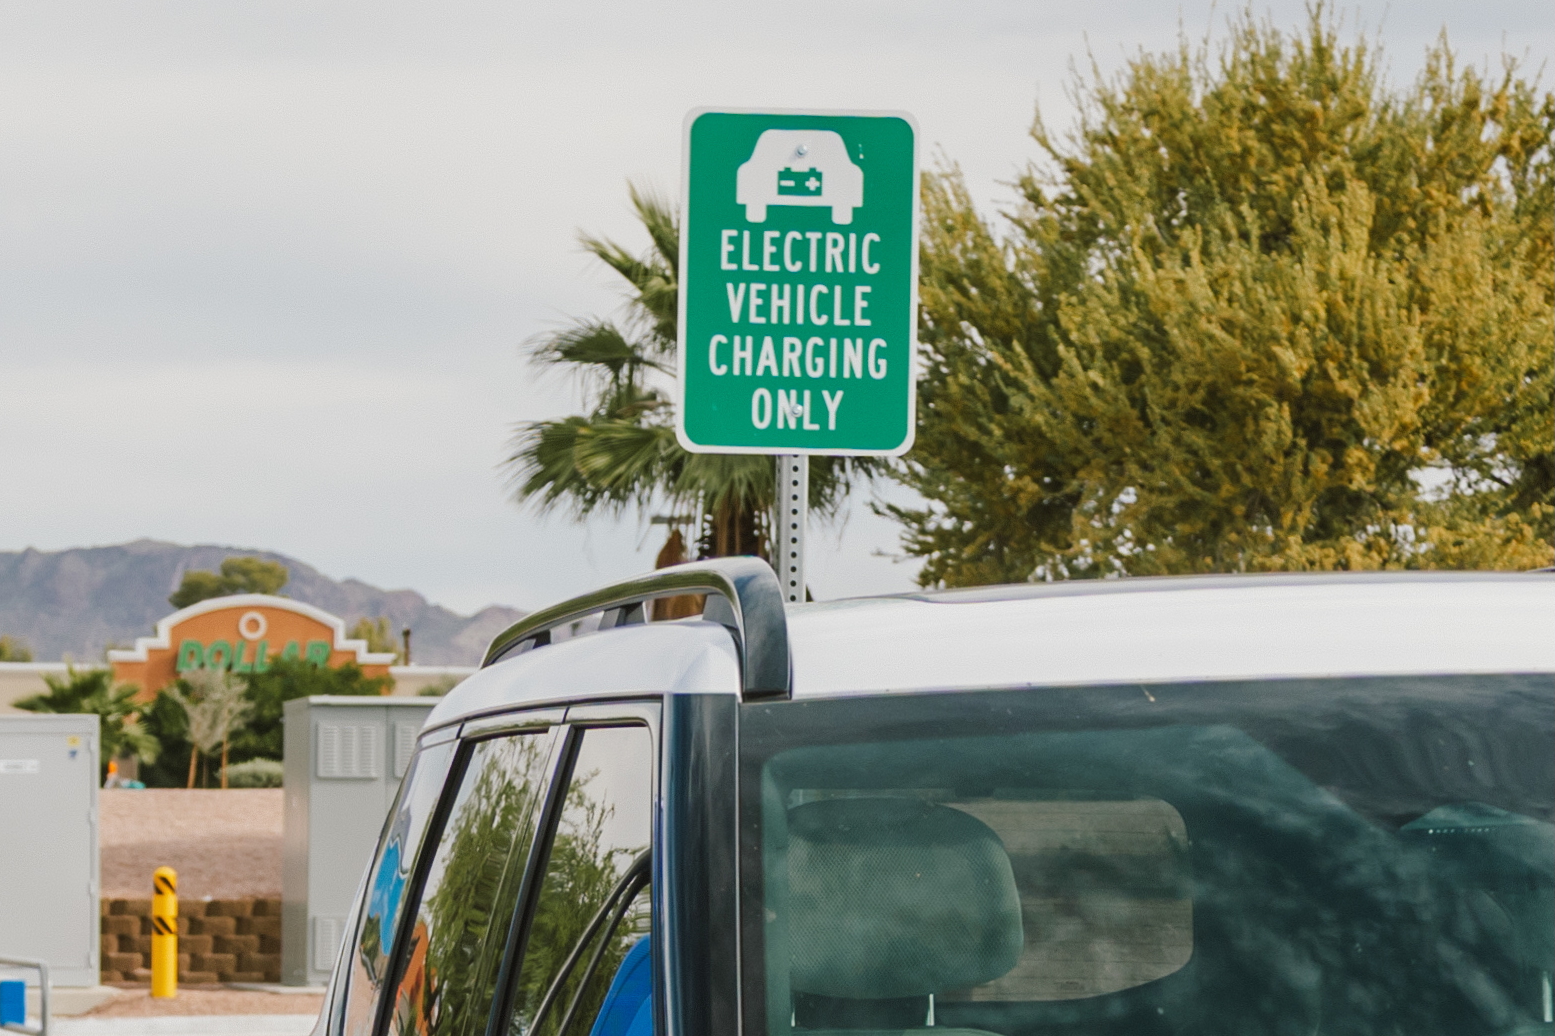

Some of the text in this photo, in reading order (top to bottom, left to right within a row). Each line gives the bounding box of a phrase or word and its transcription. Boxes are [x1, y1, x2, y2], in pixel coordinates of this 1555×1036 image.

[720, 229, 881, 275] ELECTRIC
[725, 282, 872, 327] VEHICLE
[708, 334, 888, 380] CHARGING
[751, 387, 844, 431] ONLY
[176, 639, 331, 673] DOLLAR
